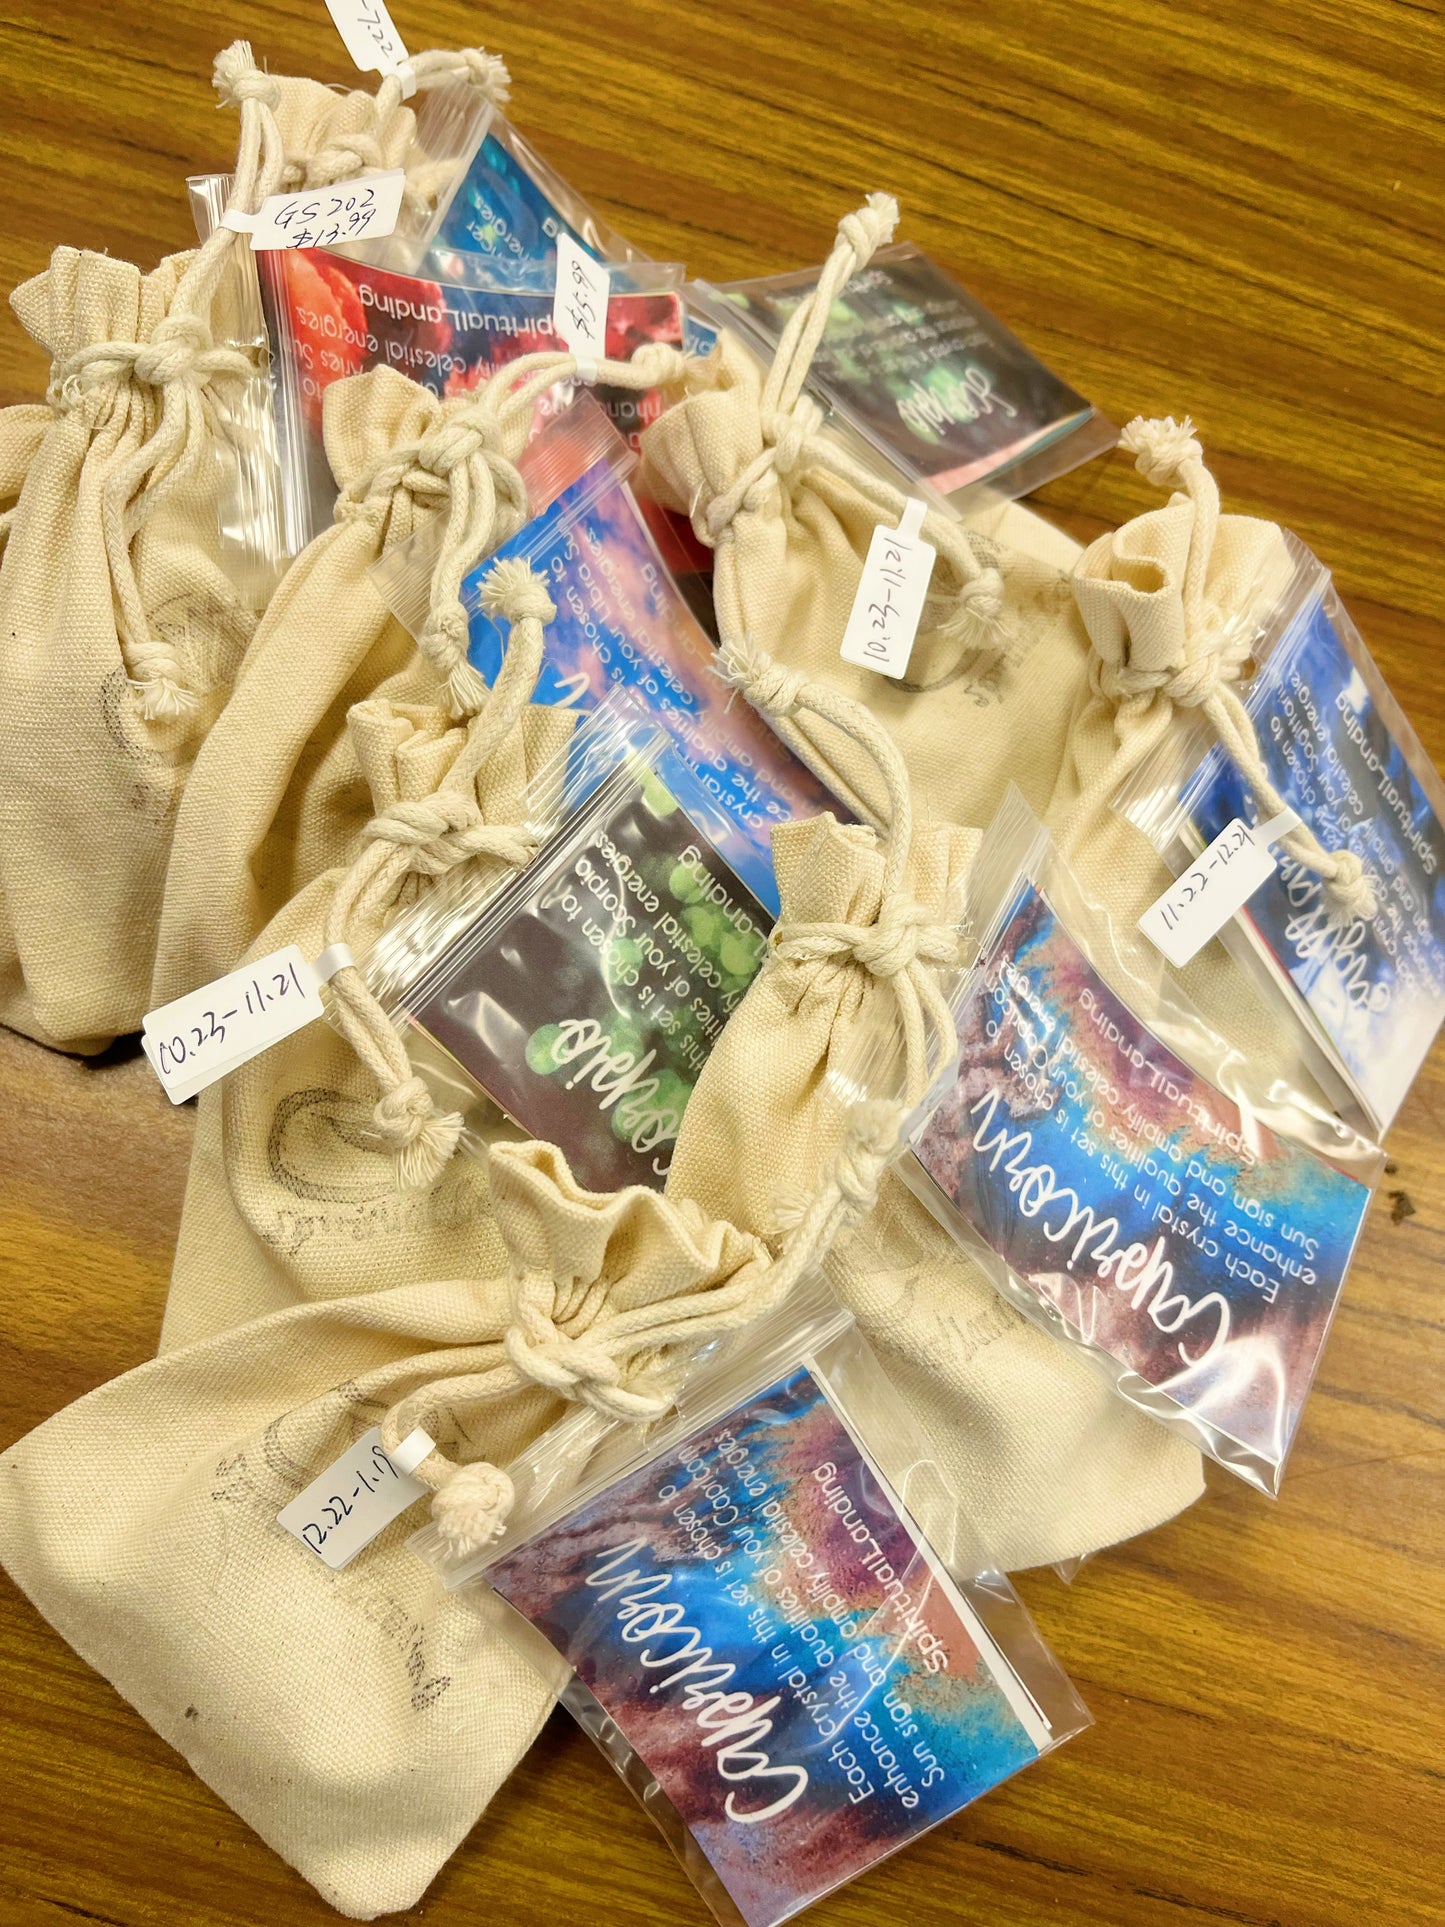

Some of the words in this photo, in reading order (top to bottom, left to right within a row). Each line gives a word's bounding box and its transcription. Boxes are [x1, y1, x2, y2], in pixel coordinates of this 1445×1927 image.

[357, 284, 555, 336] piritualLanding
[385, 340, 466, 376] celestial
[547, 554, 568, 583] to
[573, 563, 612, 623] Libra
[558, 583, 615, 664] chosen
[862, 538, 911, 661] 10.23-11.21
[605, 623, 644, 670] your
[629, 624, 695, 708] celestial
[634, 671, 661, 698] of
[1264, 714, 1287, 740] to
[727, 770, 761, 804] the
[1278, 738, 1317, 807] chosen
[1314, 767, 1346, 809] your
[1321, 741, 1366, 816] celestial
[570, 854, 638, 935] Scorpio
[1160, 825, 1254, 929] 11.22-12.21
[558, 891, 586, 921] to
[580, 917, 643, 987] chosen
[634, 930, 676, 975] your
[652, 910, 723, 991] celestial
[633, 983, 657, 1006] is
[664, 973, 692, 1002] of
[161, 962, 304, 1074] 10.23-11.21
[648, 1002, 684, 1035] set
[1000, 1043, 1057, 1110] chosen
[1045, 1063, 1086, 1106] your
[1051, 1033, 1123, 1104] celestial
[1077, 987, 1261, 1165] SpiritualLanding
[1052, 1109, 1068, 1130] is
[1069, 1126, 1098, 1155] set
[1081, 1104, 1107, 1131] of
[1119, 1100, 1185, 1161] amplify
[1095, 1118, 1184, 1195] qualities
[1096, 1152, 1131, 1190] this
[1180, 1158, 1229, 1200] and
[1127, 1183, 1153, 1208] in
[1180, 1189, 1222, 1226] the
[1228, 1188, 1277, 1231] sign
[972, 1088, 1230, 1361] Capricorn
[1150, 1202, 1220, 1256] crystal
[1220, 1216, 1318, 1284] enhance
[1274, 1220, 1321, 1261] Sun
[1222, 1250, 1282, 1303] Each
[302, 1445, 398, 1553] 12.22-1.19
[668, 1498, 722, 1565] chosen
[729, 1519, 772, 1566] your
[750, 1495, 816, 1570] celestial
[709, 1558, 734, 1580] is
[722, 1576, 753, 1609] set
[752, 1558, 784, 1590] of
[806, 1457, 954, 1676] SpiritualLanding
[740, 1606, 777, 1646] this
[769, 1582, 840, 1672] qualities
[798, 1566, 864, 1645] amplify
[584, 1531, 808, 1819] Capricorn
[763, 1641, 791, 1668] in
[846, 1640, 889, 1690] and
[779, 1664, 837, 1734] crystal
[823, 1669, 860, 1709] the
[877, 1686, 923, 1739] sign
[821, 1737, 876, 1804] Each
[849, 1708, 922, 1811] enhance
[903, 1738, 948, 1788] Sun
